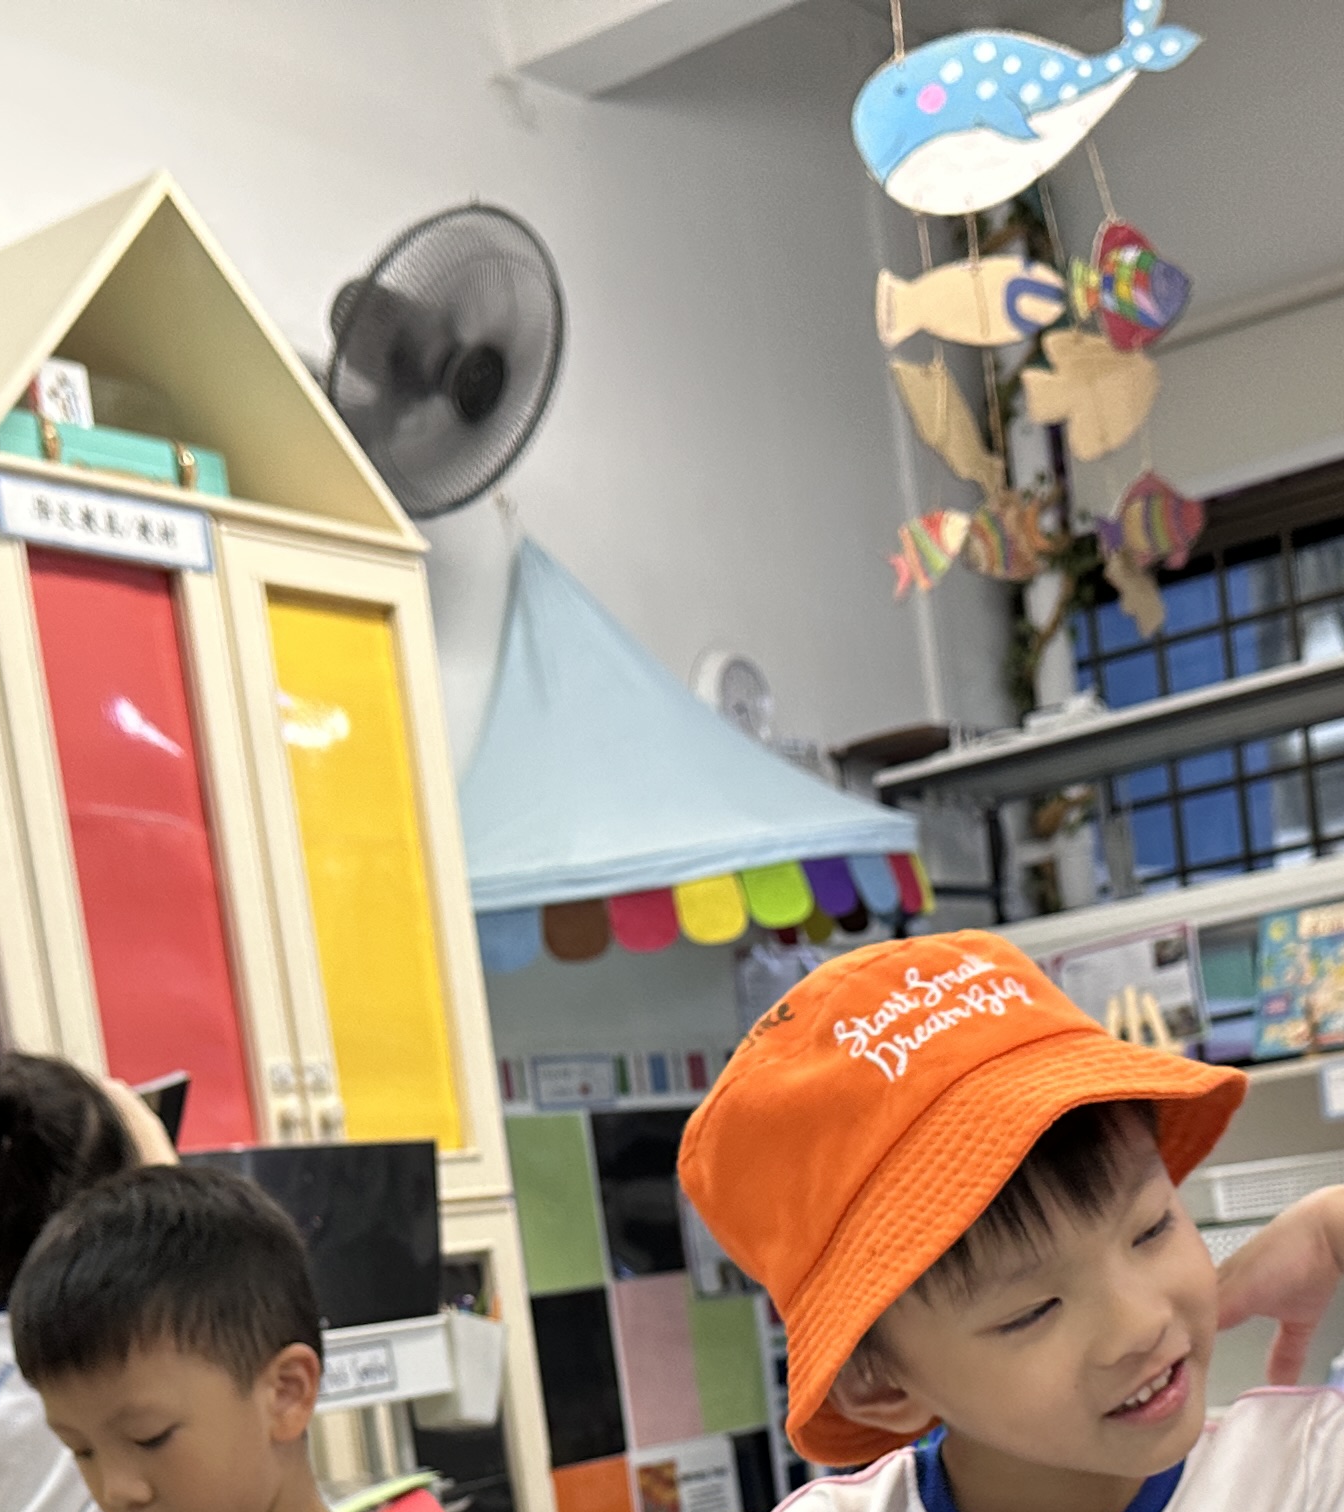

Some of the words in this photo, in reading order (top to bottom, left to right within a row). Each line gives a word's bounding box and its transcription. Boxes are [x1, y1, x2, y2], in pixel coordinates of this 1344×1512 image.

[833, 991, 920, 1058] Start
[863, 1006, 971, 1083] Dream
[957, 977, 1034, 1016] Big
